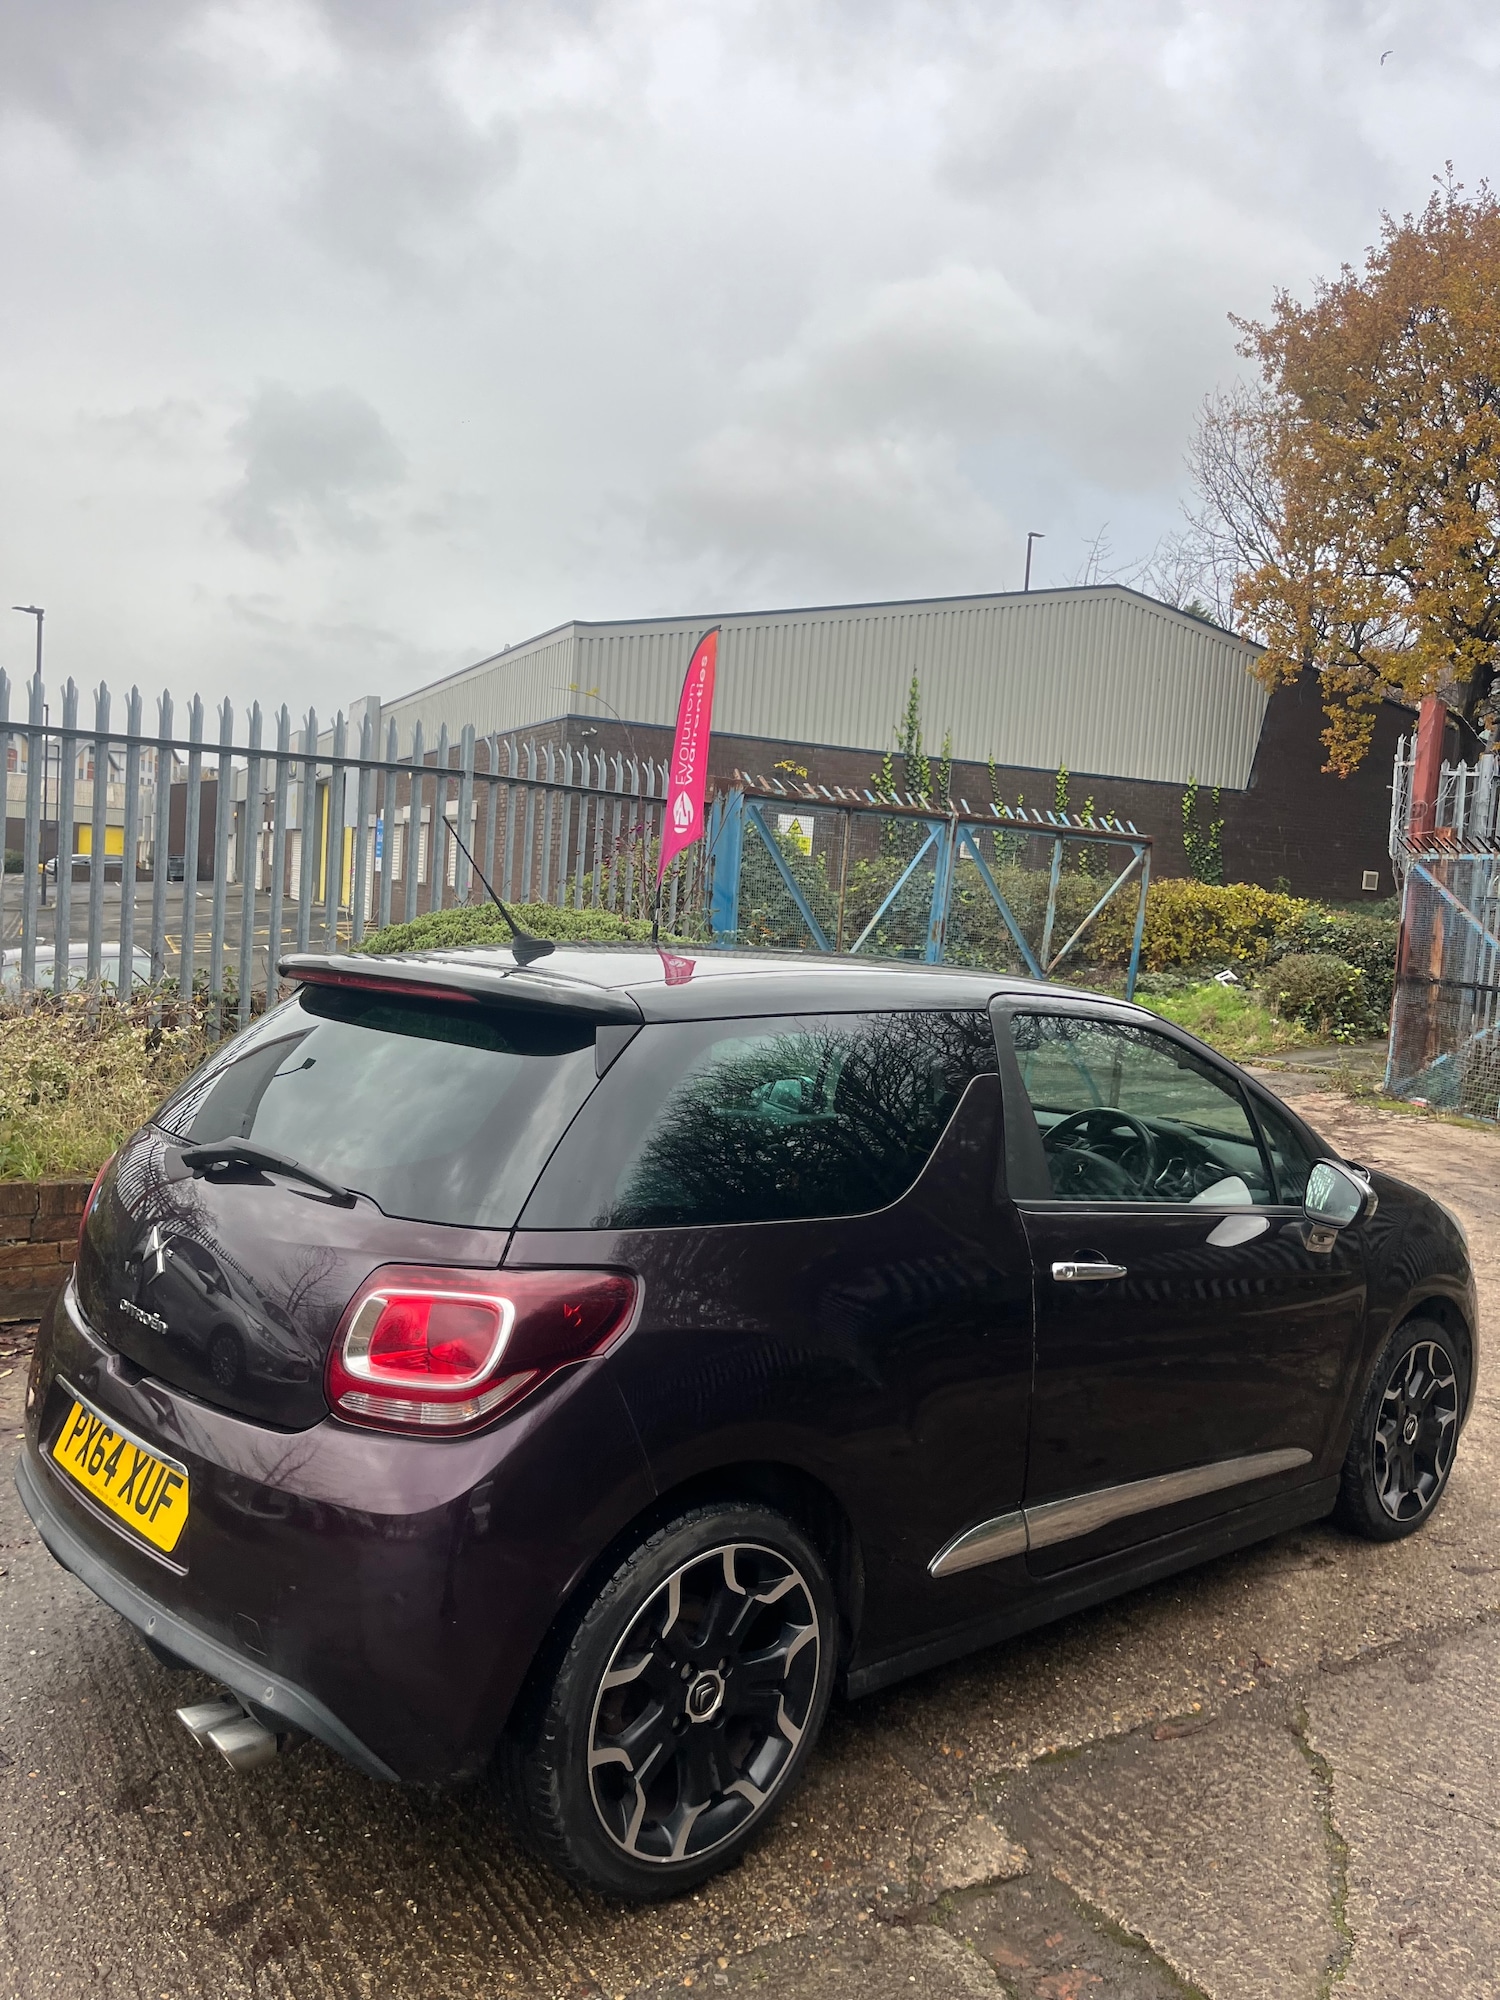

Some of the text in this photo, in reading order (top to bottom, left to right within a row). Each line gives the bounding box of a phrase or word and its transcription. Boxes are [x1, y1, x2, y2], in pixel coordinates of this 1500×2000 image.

[675, 683, 696, 785] Evolution
[685, 655, 708, 785] Warranties
[64, 1408, 184, 1523] PX64 XUF
